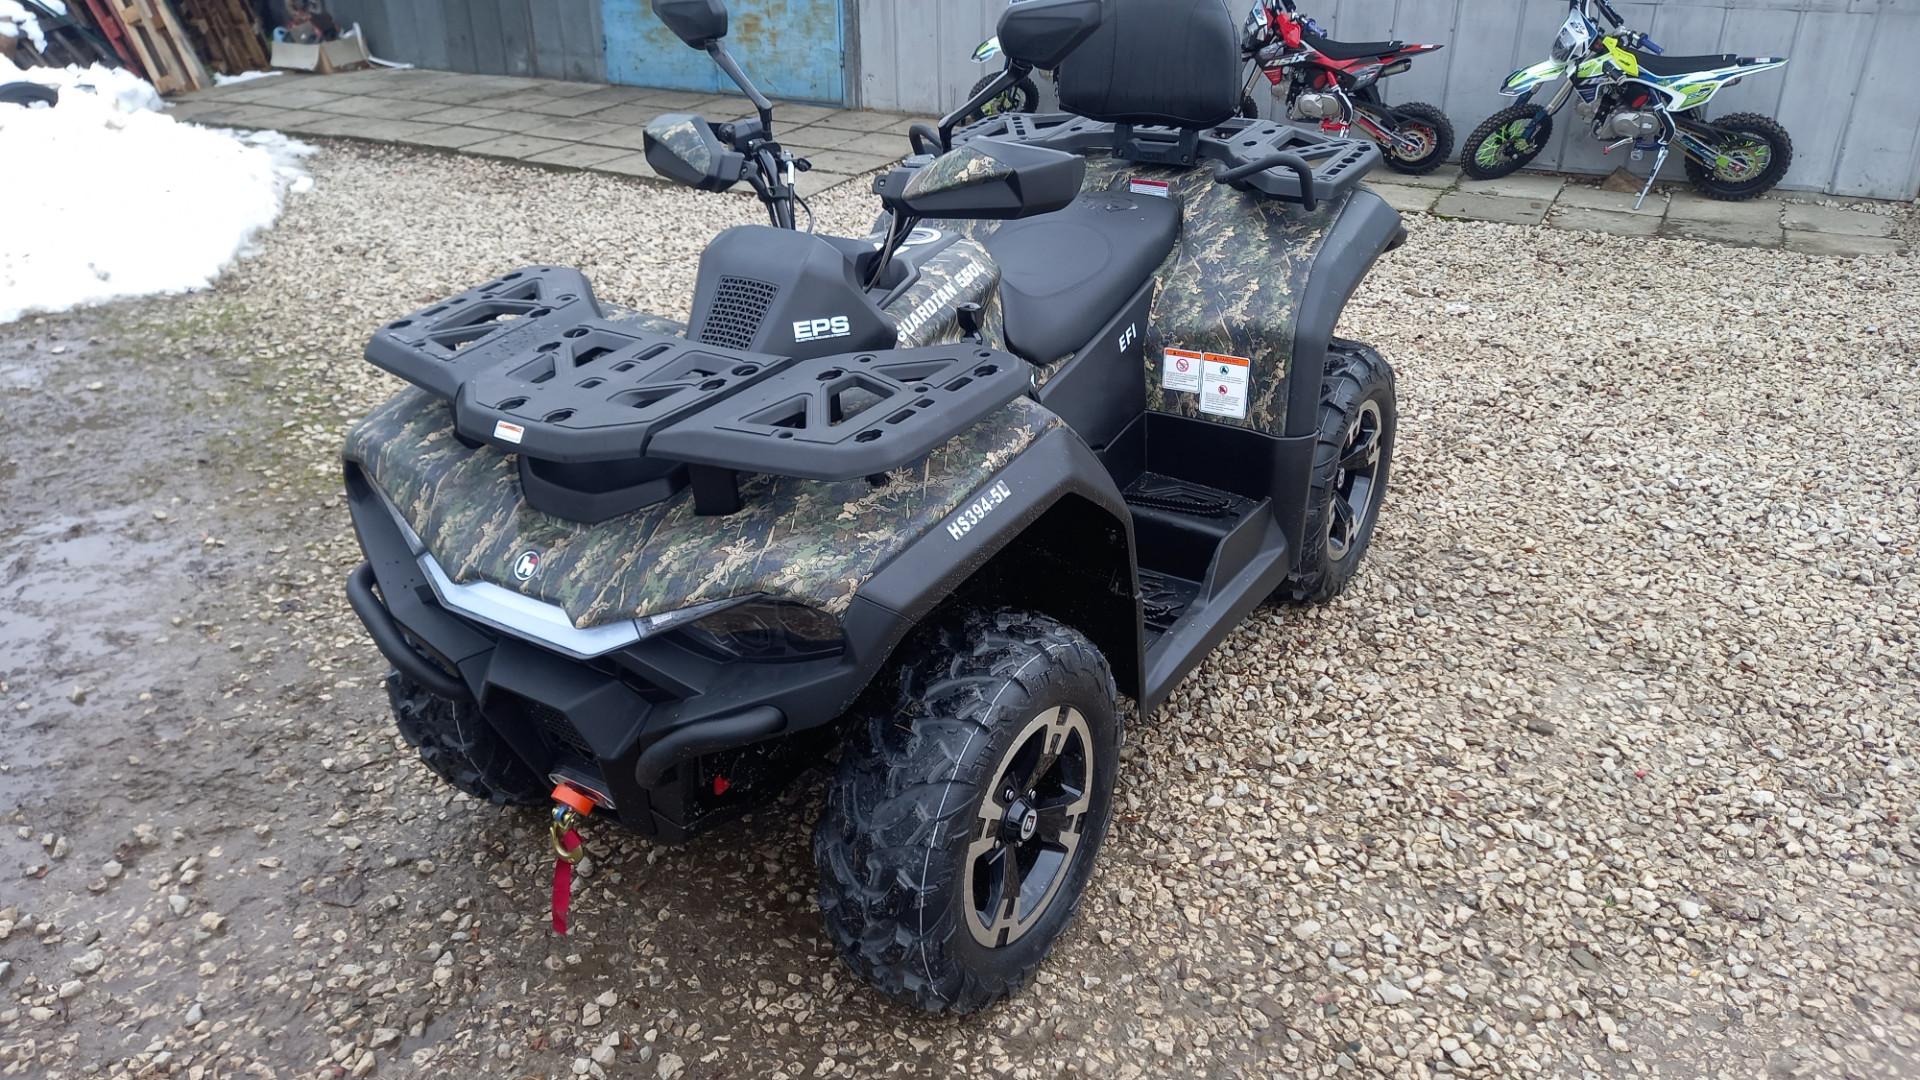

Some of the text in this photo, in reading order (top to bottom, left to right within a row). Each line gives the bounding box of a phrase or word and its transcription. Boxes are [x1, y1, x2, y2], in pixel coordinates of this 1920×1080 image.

[793, 315, 850, 340] EPS
[896, 281, 958, 342] GUARDIAN
[1118, 322, 1137, 353] EFI
[946, 479, 1012, 541] HS394-5L
